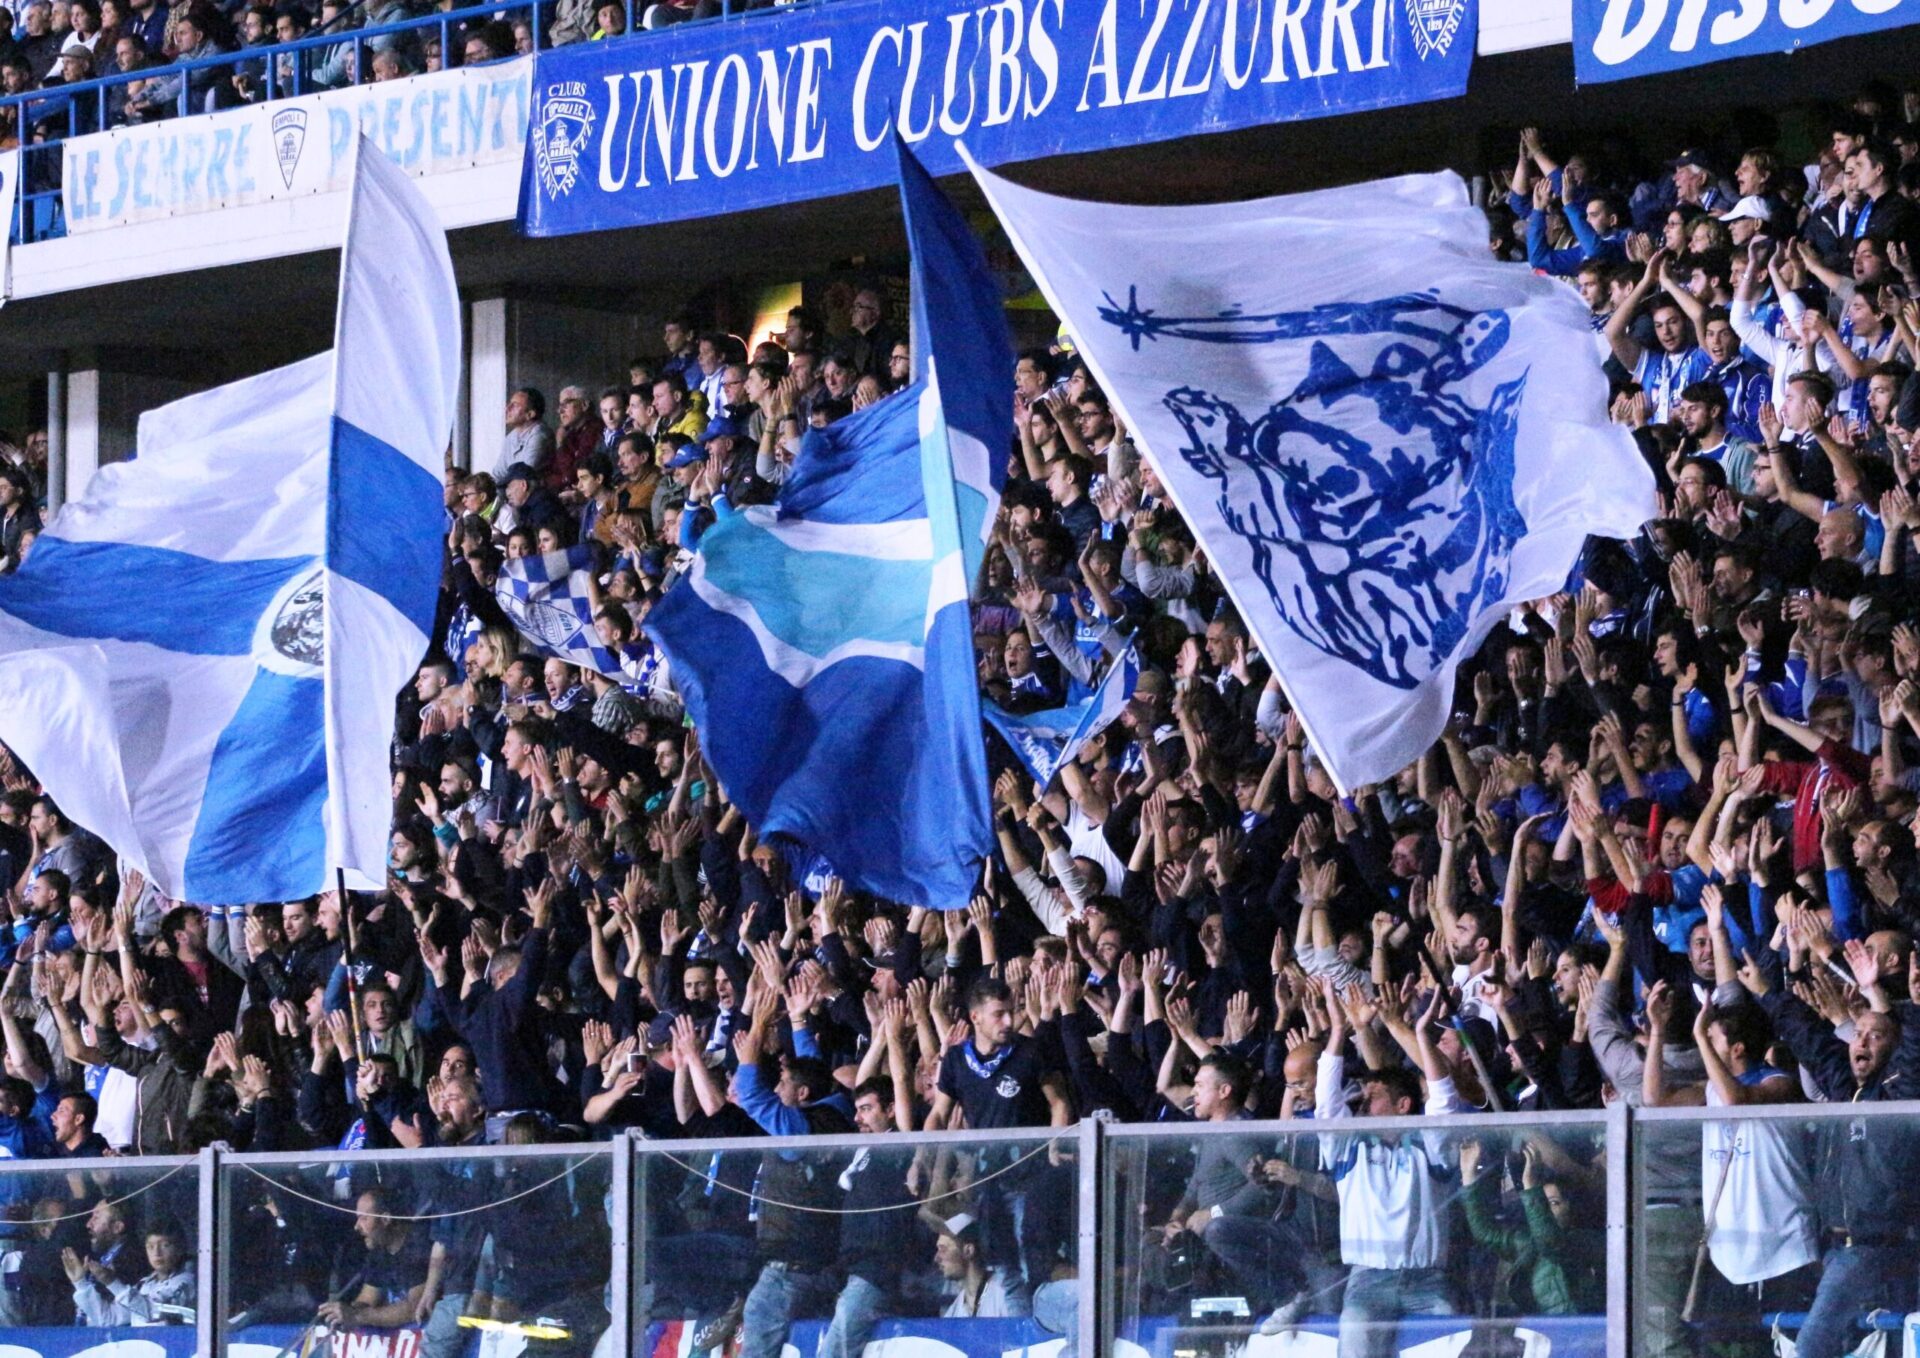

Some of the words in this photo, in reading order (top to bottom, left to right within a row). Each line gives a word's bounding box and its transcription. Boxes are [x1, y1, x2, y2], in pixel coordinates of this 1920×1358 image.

[548, 81, 587, 97] CLUBS
[599, 38, 832, 192] UNIONE
[852, 0, 1064, 151] CLUBS
[1075, 0, 1390, 112] AZZURRI
[69, 149, 102, 221] LE
[108, 123, 256, 219] SEMPRE
